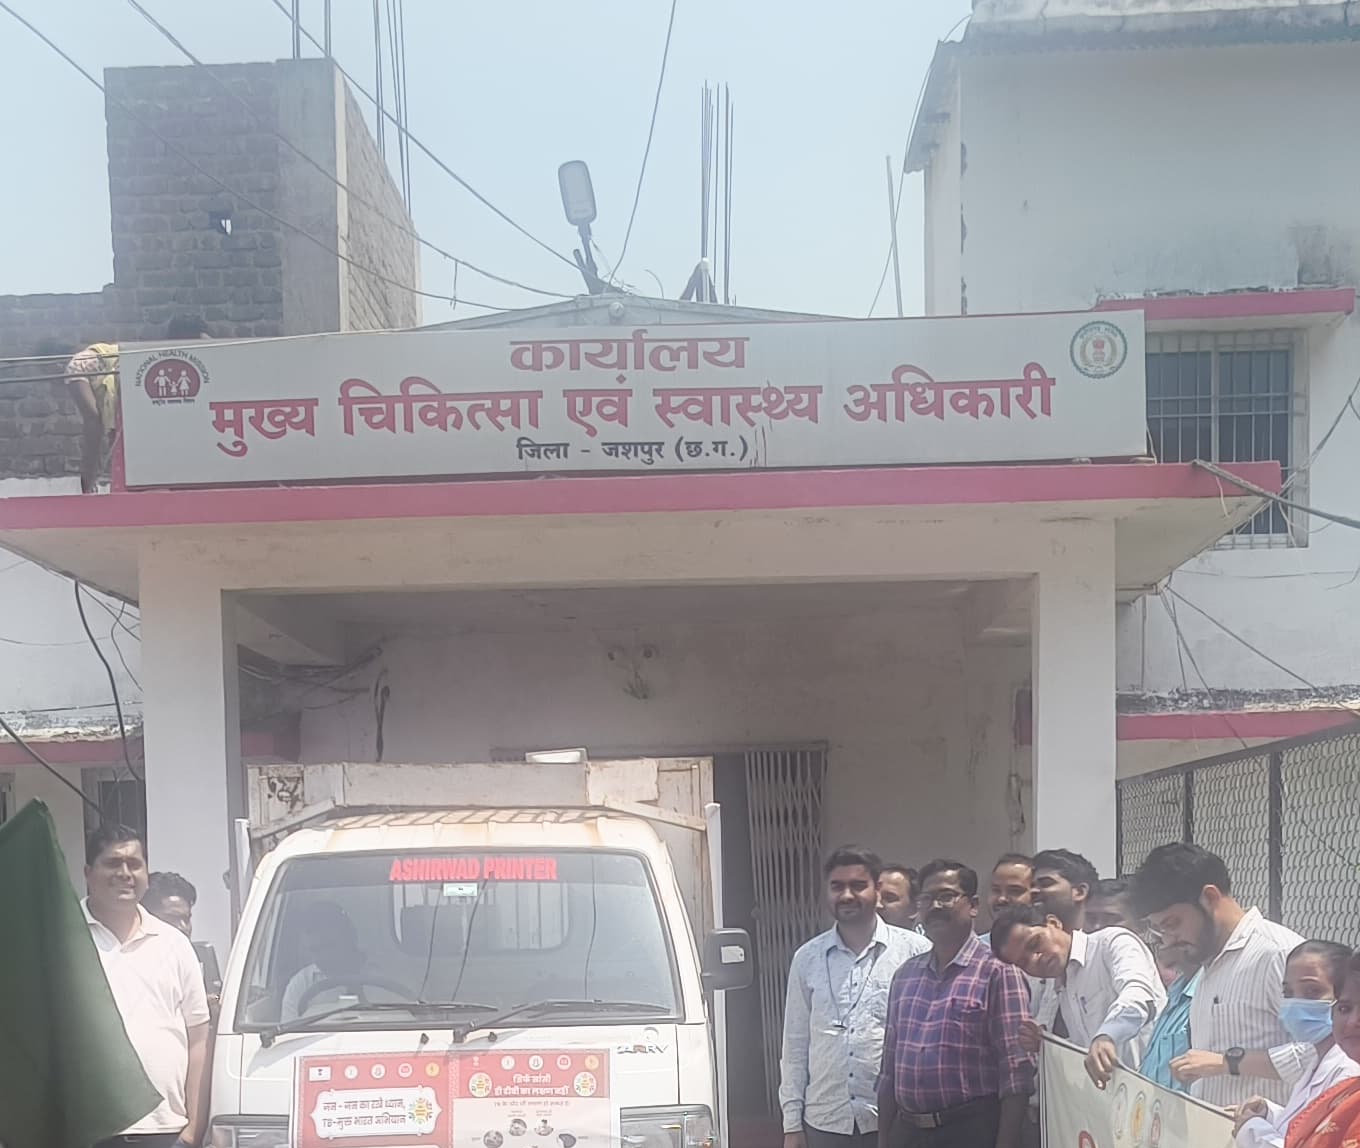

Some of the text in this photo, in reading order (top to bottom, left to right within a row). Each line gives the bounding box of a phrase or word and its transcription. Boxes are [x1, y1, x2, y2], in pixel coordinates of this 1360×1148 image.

[509, 329, 750, 372] कार्यालय
[209, 362, 1056, 457] मुख्य चिकित्सा एवं स्वास्थ्य अधिकारी
[516, 436, 570, 460] जिला
[601, 440, 665, 465] जशपुर
[390, 856, 557, 881] ASHIRWAD PRINTER
